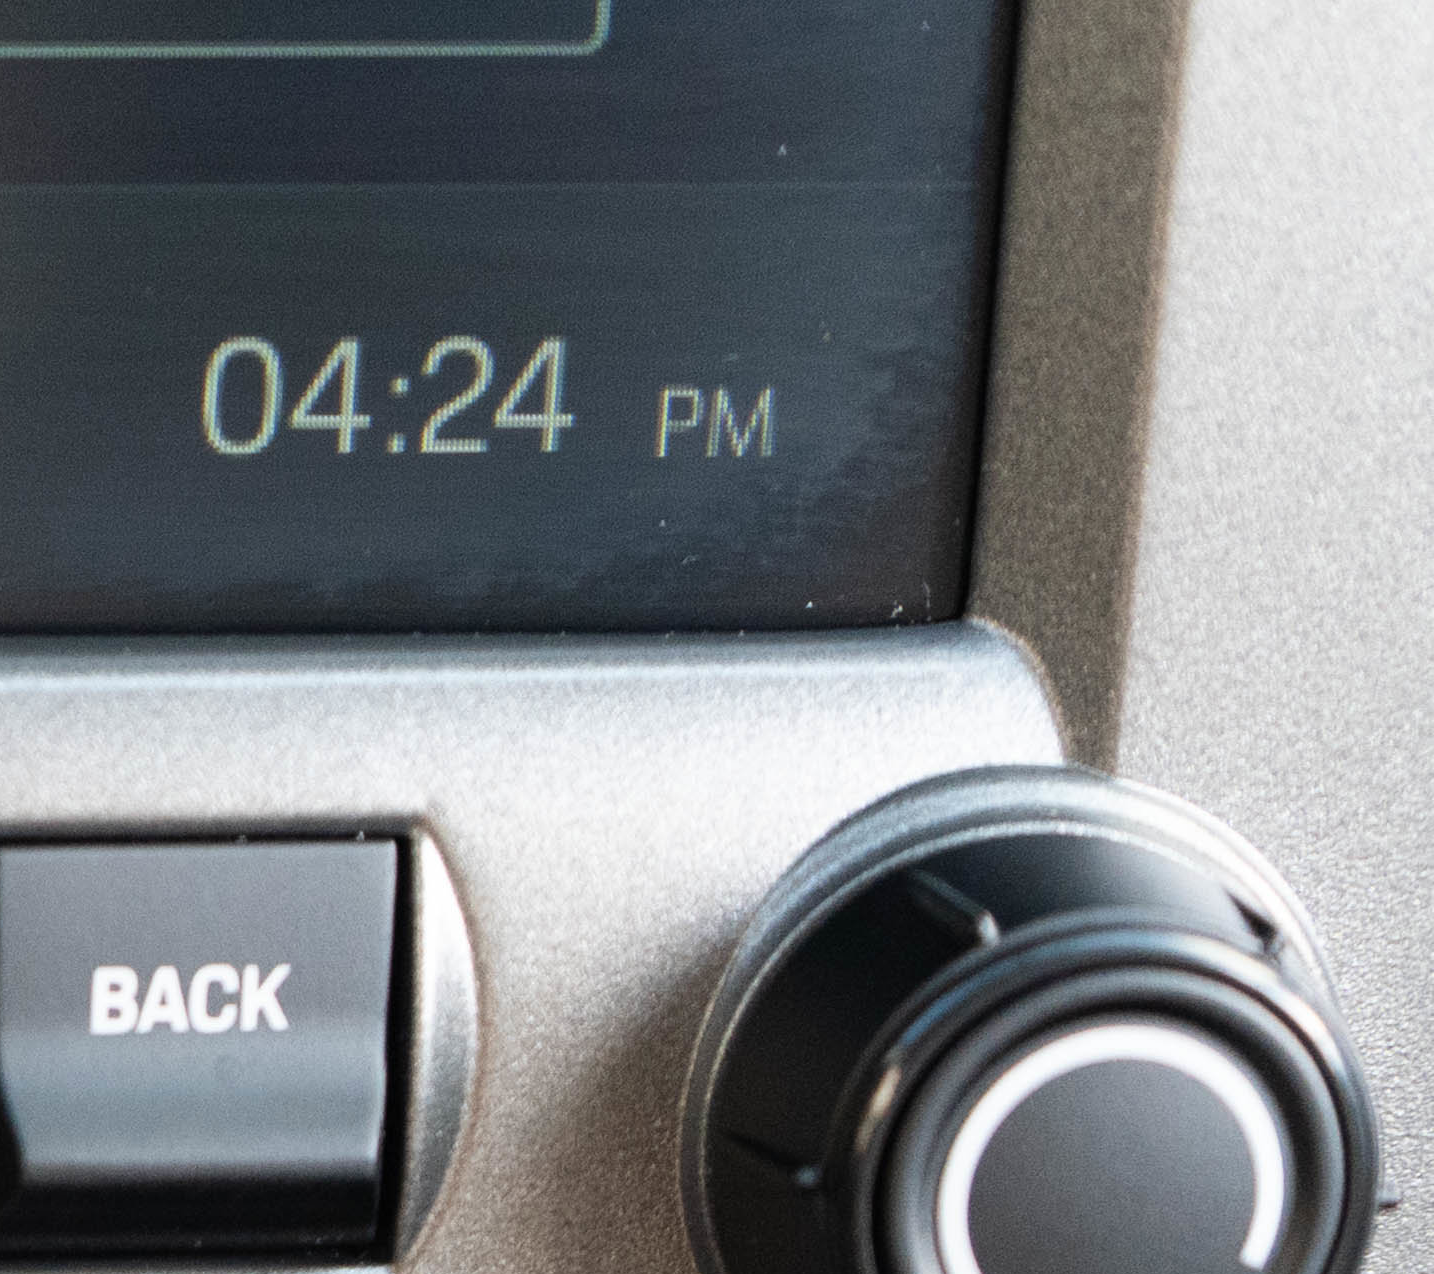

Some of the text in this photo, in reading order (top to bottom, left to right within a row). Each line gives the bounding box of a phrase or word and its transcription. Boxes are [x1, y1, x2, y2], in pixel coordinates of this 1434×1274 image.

[200, 334, 777, 459] 04:24 PM
[87, 962, 291, 1038] BACK
